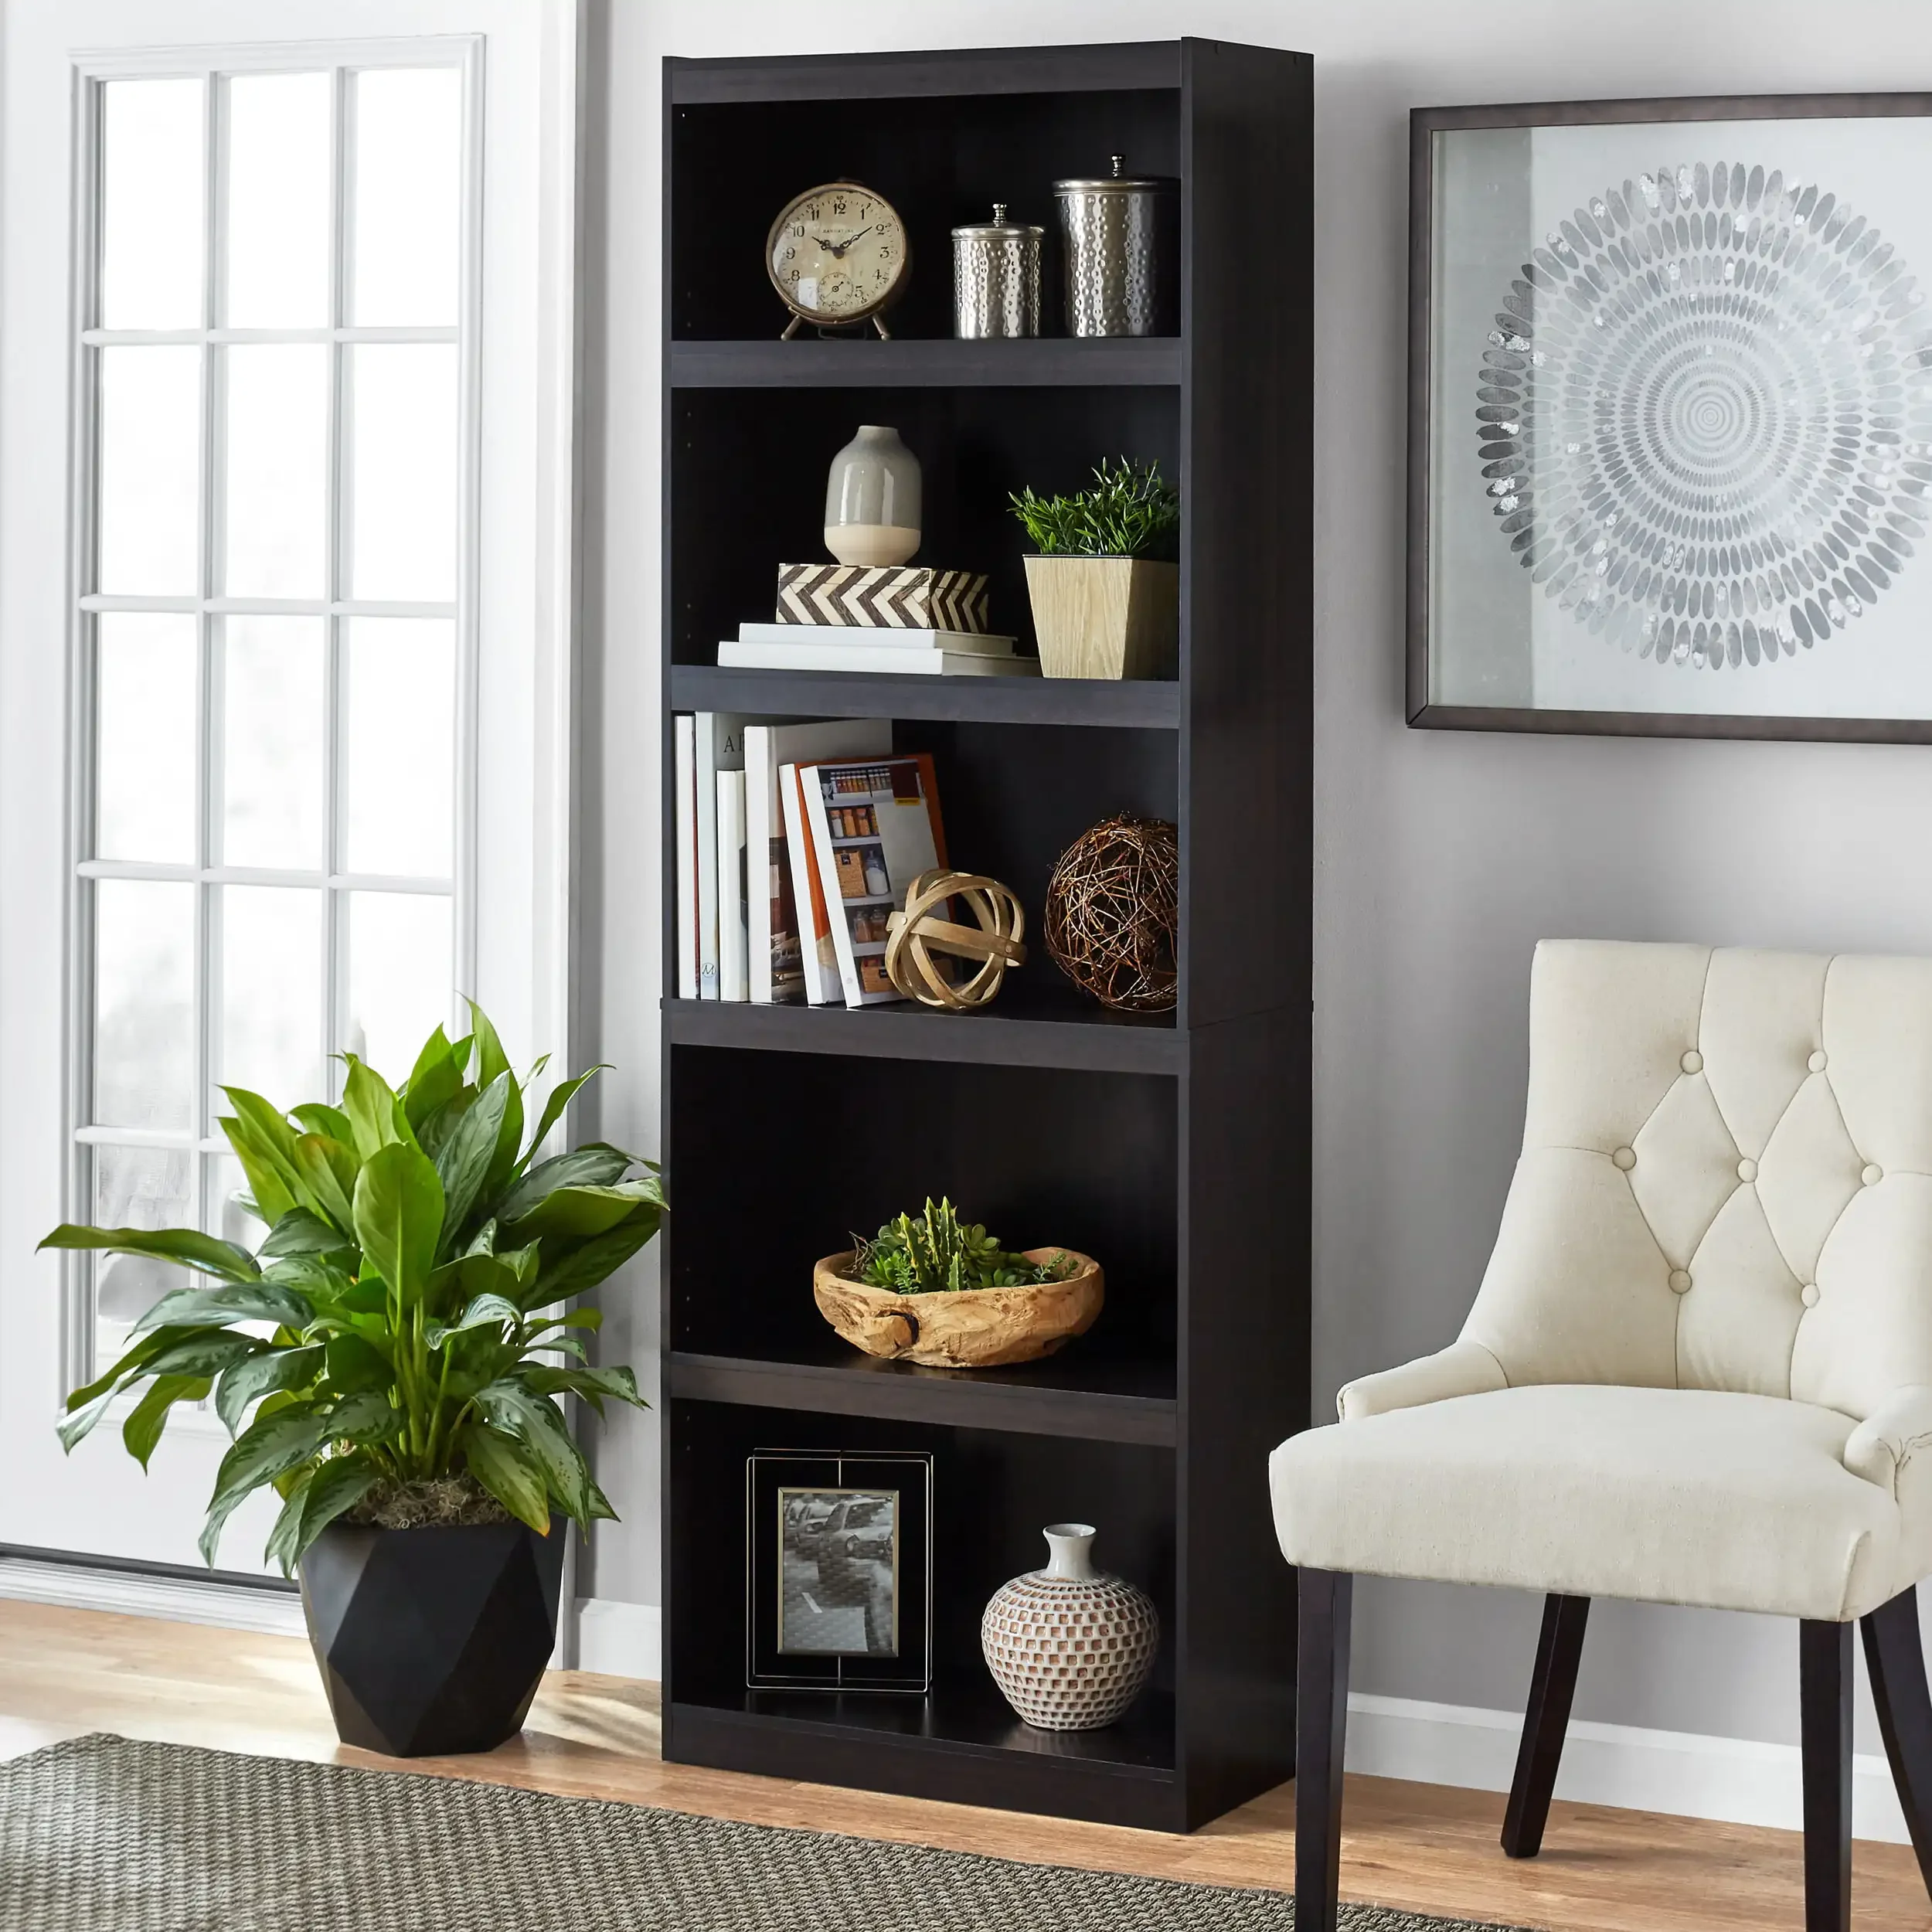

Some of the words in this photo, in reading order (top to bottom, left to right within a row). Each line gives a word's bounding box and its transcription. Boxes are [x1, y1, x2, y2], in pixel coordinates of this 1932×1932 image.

[834, 202, 846, 214] 12
[860, 208, 865, 219] 1
[811, 209, 820, 221] 11
[792, 225, 804, 238] 10
[876, 223, 885, 235] 2
[786, 247, 796, 260] 9
[879, 246, 889, 258] 3
[791, 270, 801, 281] 8
[872, 269, 883, 280] 4
[855, 285, 863, 298] 5
[702, 964, 715, 975] M
